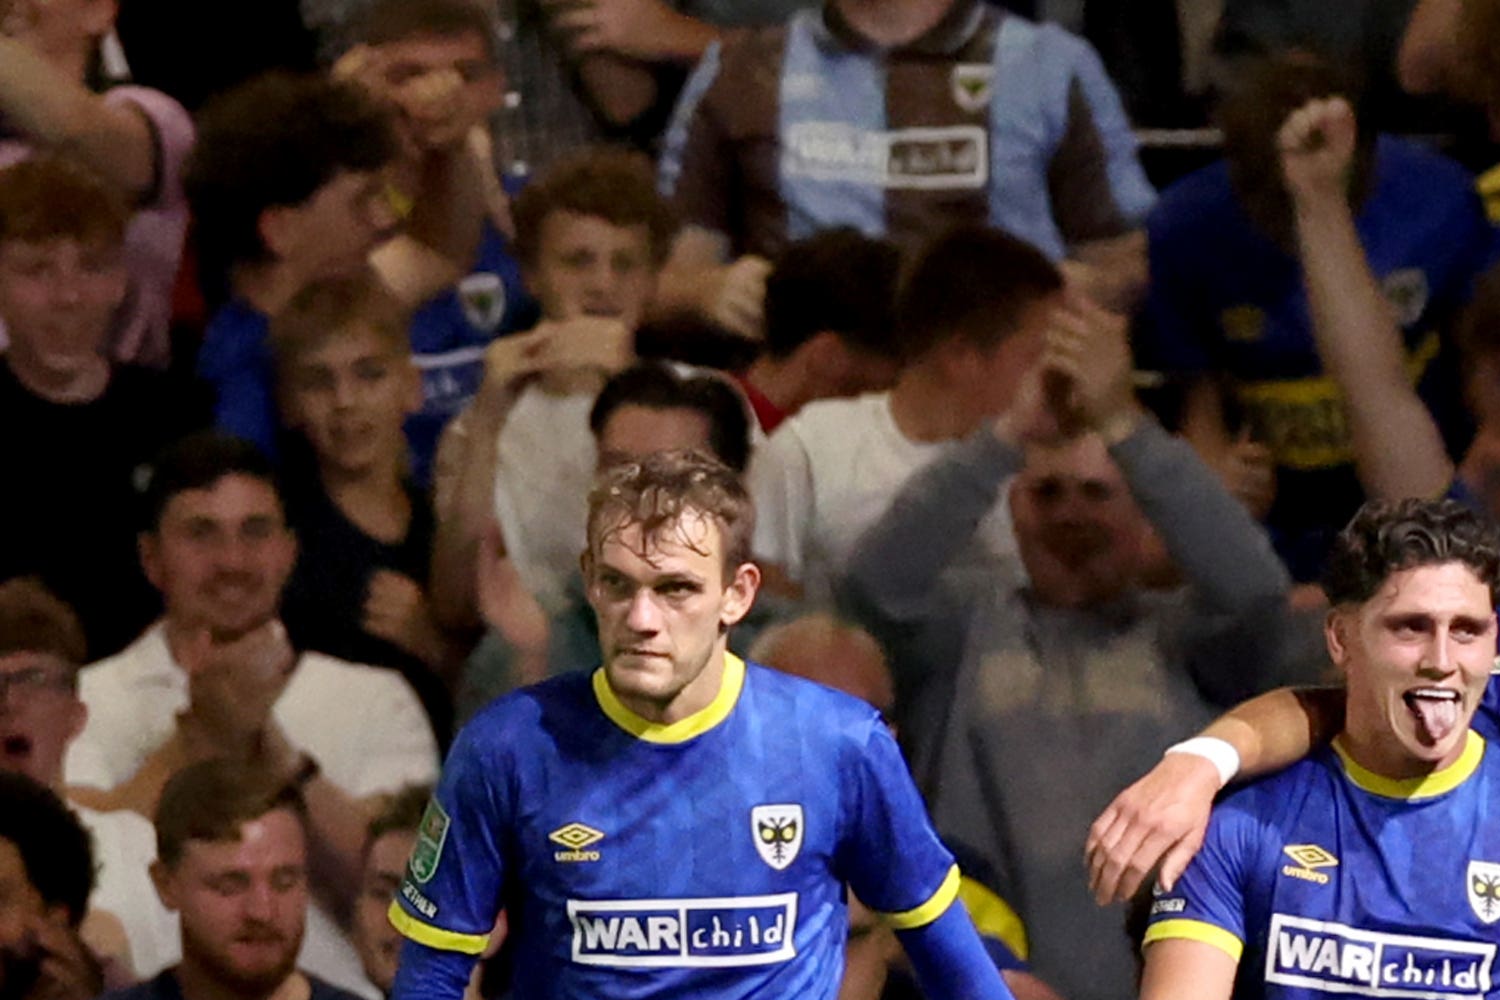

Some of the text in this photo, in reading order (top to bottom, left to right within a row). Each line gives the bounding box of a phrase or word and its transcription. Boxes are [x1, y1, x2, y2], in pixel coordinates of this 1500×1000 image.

[554, 849, 600, 862] umbro
[1283, 865, 1328, 884] umbro
[578, 913, 784, 952] WAR child
[1278, 931, 1479, 989] WAR child
